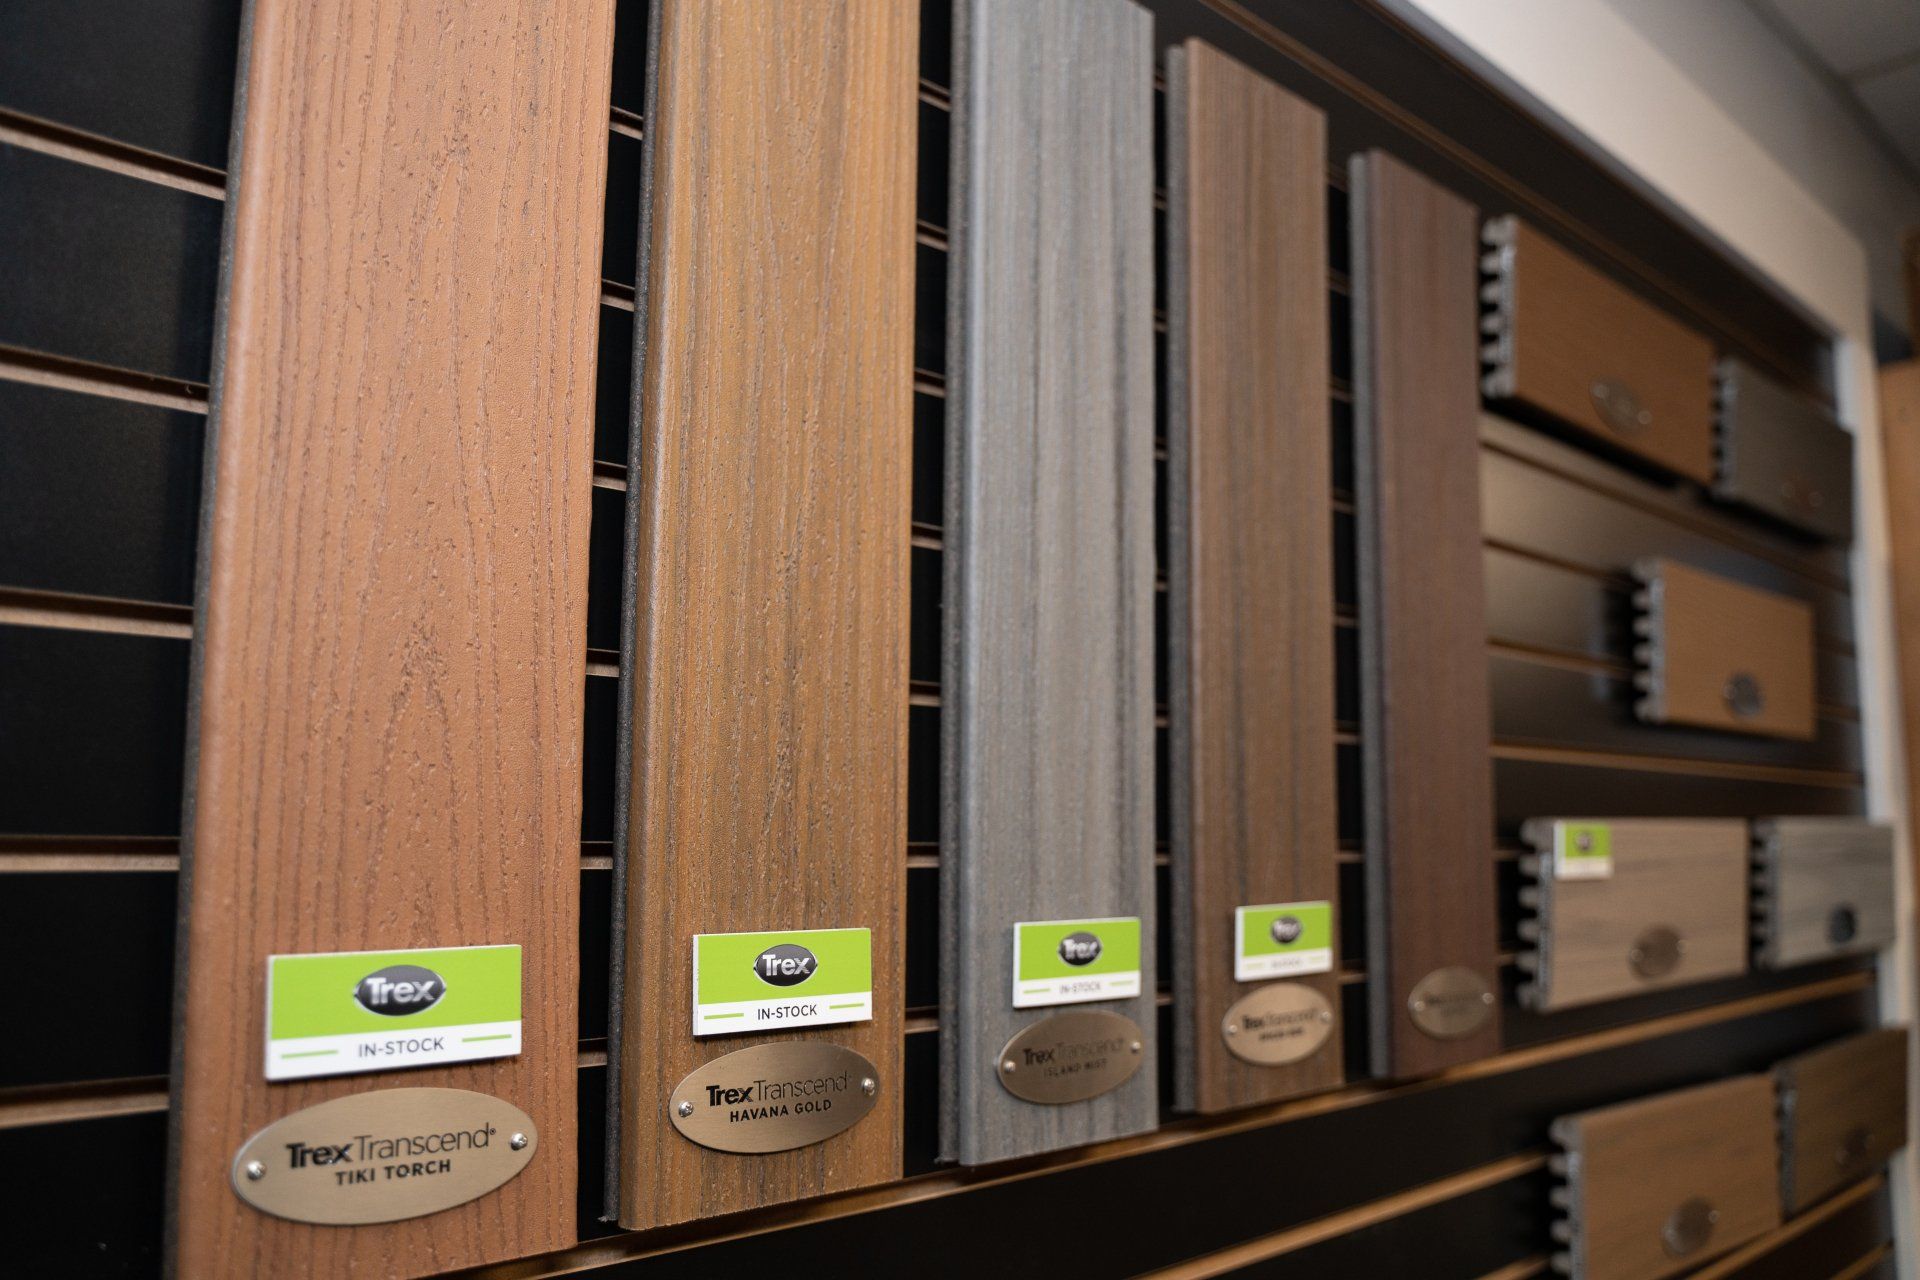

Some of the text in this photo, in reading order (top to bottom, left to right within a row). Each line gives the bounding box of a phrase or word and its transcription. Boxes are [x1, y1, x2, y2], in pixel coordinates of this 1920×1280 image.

[1063, 938, 1099, 960] Trex
[762, 954, 812, 977] Trex
[366, 976, 436, 1006] Trex
[757, 1004, 818, 1021] IN-STOCK
[358, 1036, 445, 1058] IN-STOCK
[729, 1099, 832, 1123] HAVANA GOLD
[336, 1159, 452, 1186] TIKI TORCH
